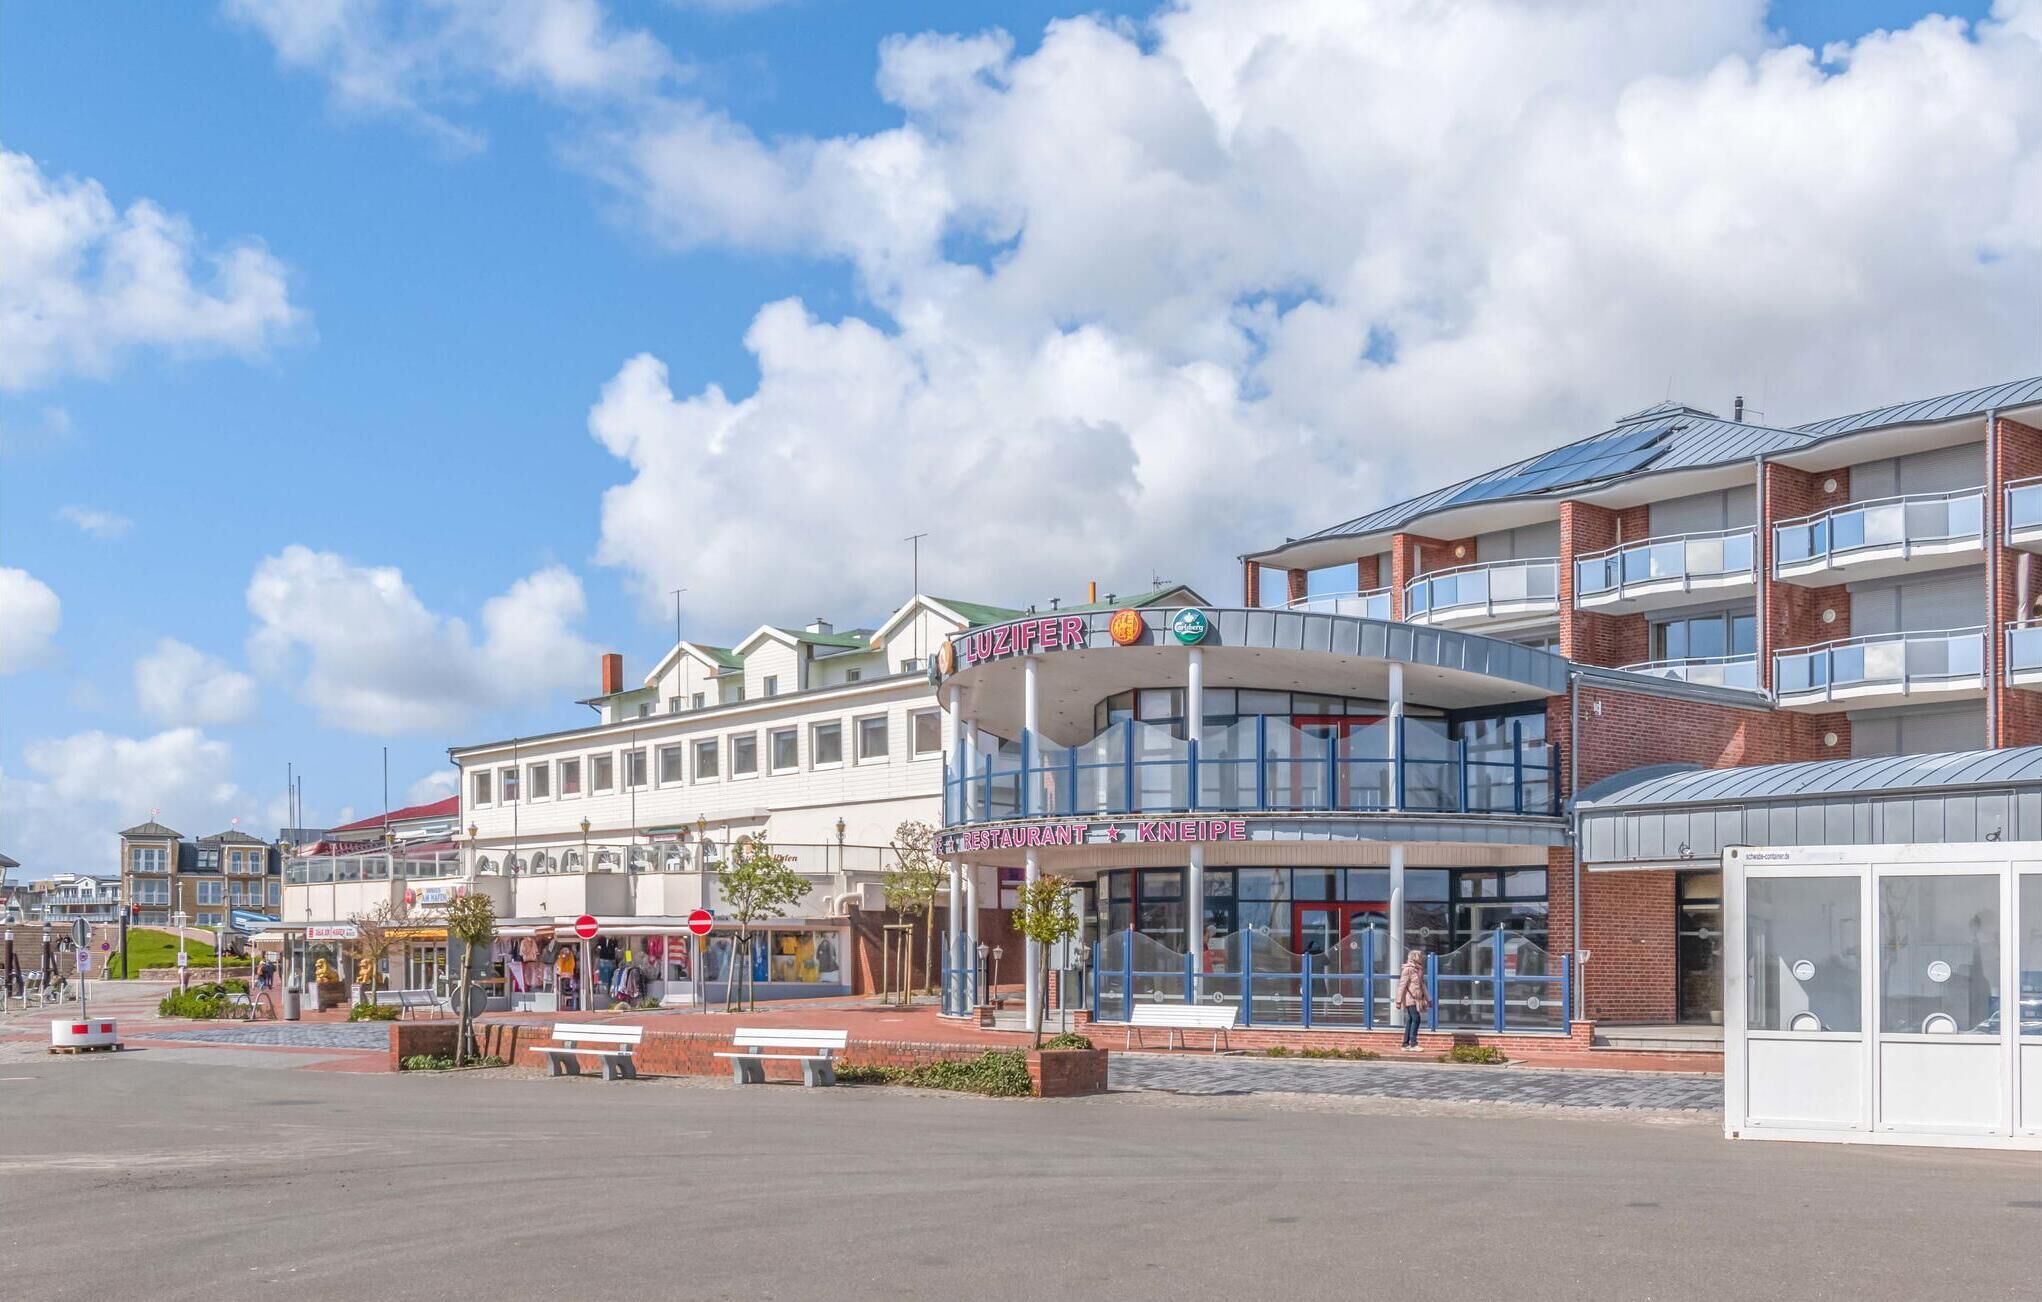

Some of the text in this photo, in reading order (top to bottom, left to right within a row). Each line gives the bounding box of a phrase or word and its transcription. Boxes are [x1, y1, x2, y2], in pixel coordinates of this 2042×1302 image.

[965, 616, 1084, 663] LUZIFER
[1174, 621, 1204, 633] Carlsberg
[962, 824, 1088, 850] RESTAURANT
[1138, 820, 1247, 841] KNEIPE
